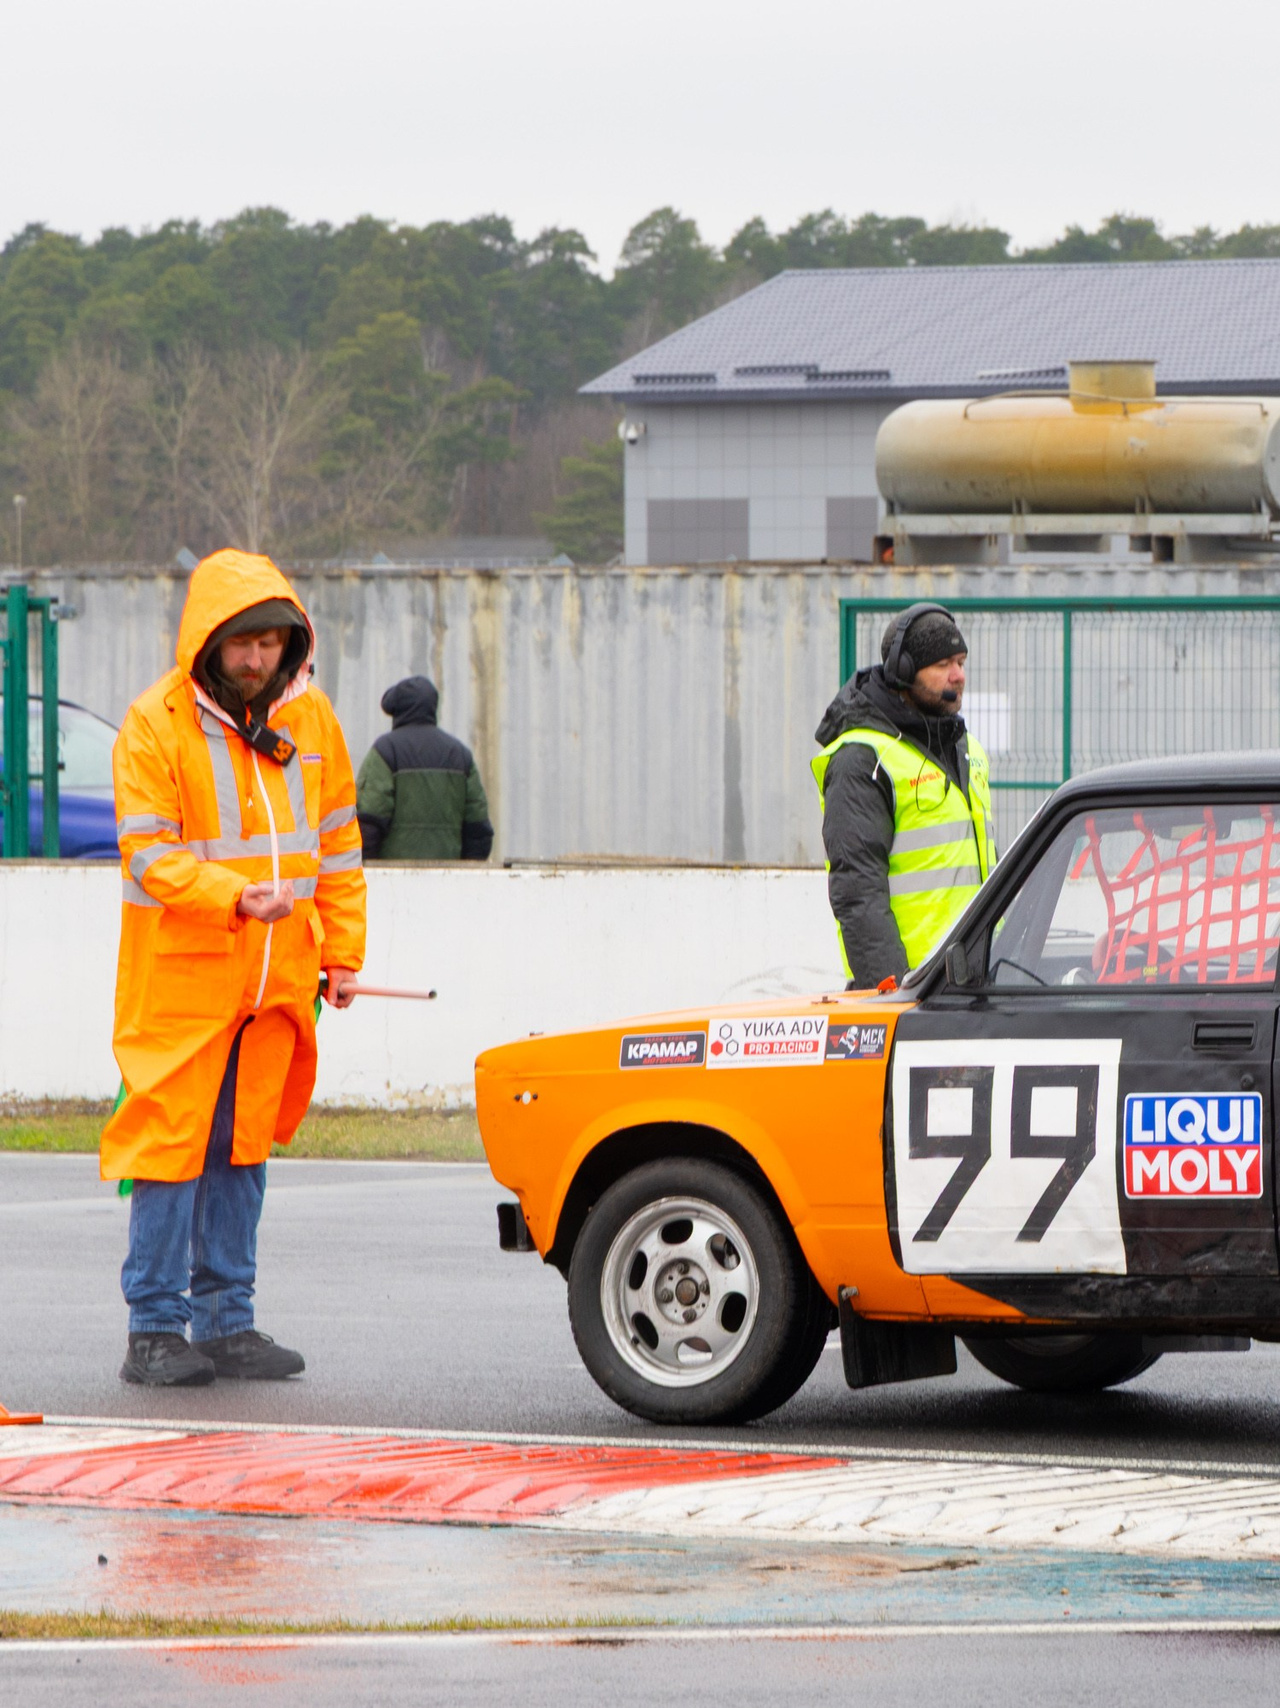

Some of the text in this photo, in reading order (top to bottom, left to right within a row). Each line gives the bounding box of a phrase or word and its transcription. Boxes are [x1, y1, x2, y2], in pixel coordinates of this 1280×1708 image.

[743, 1020, 825, 1037] YUKA ADV
[860, 1028, 885, 1045] МСК
[628, 1041, 698, 1060] КРАМАР
[748, 1041, 814, 1055] PRO RACING
[1132, 1098, 1255, 1146] LIQUI
[909, 1064, 1100, 1243] 99
[1132, 1148, 1259, 1193] MOLY
